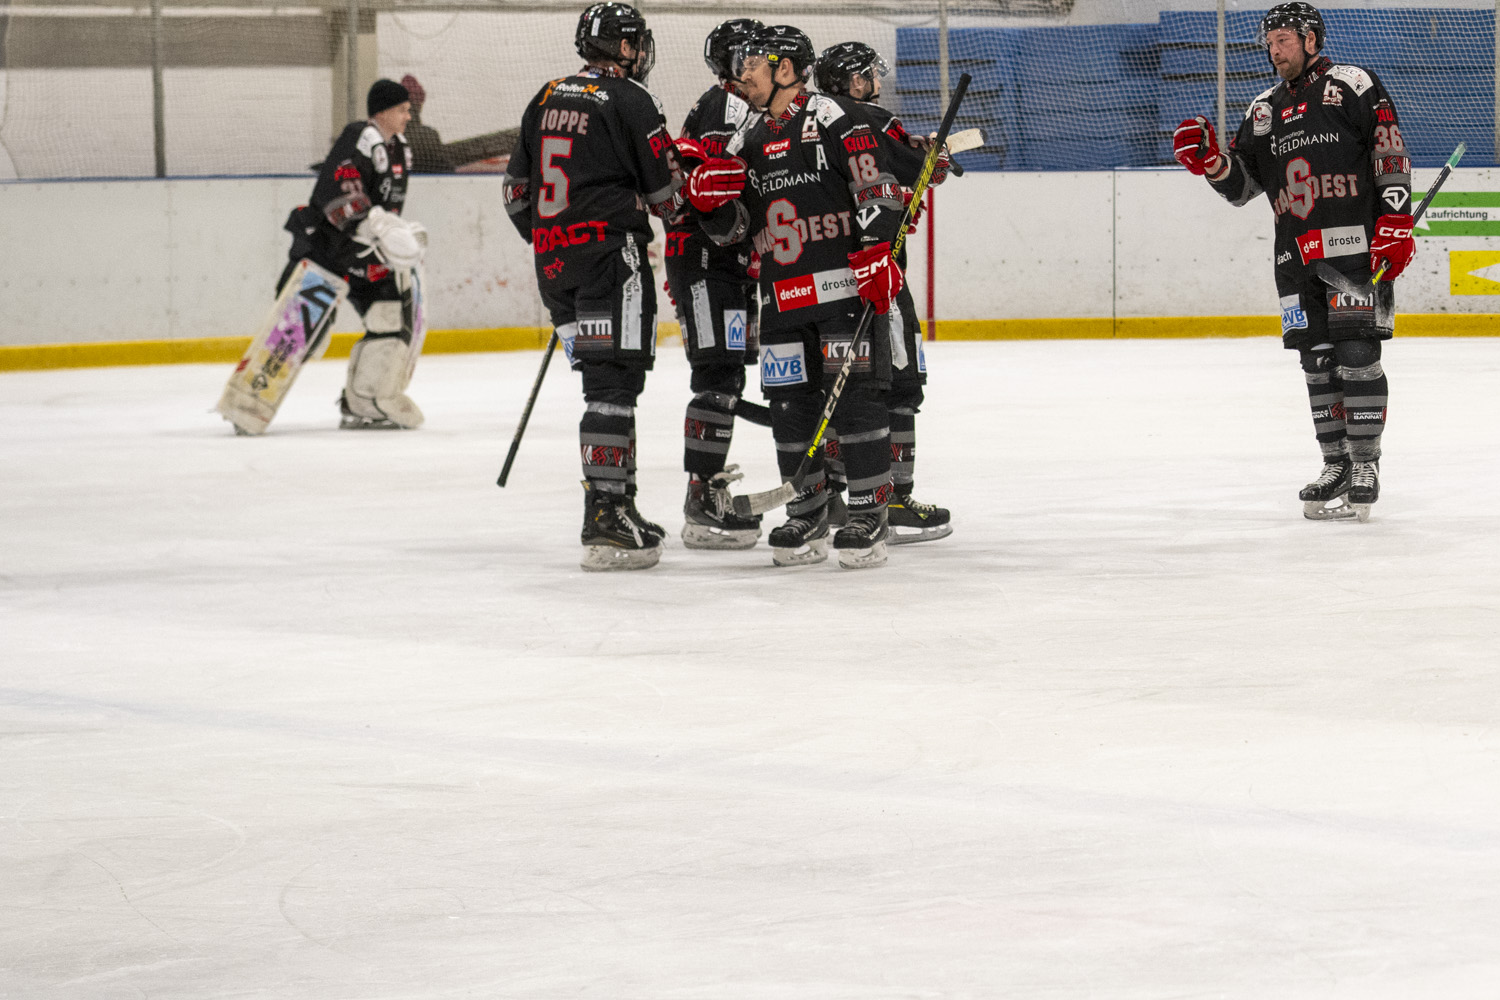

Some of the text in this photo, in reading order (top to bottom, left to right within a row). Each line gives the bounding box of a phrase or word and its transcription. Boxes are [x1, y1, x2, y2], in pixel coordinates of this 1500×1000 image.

[1279, 132, 1339, 156] FELDMANN
[1374, 124, 1404, 154] 36
[816, 144, 829, 171] A
[537, 136, 573, 219] 5
[848, 153, 879, 187] 18
[1425, 211, 1488, 220] Laufrichtung
[1328, 235, 1361, 247] droste
[854, 255, 889, 279] CM
[780, 276, 855, 300] decker droste
[764, 359, 801, 377] MVB
